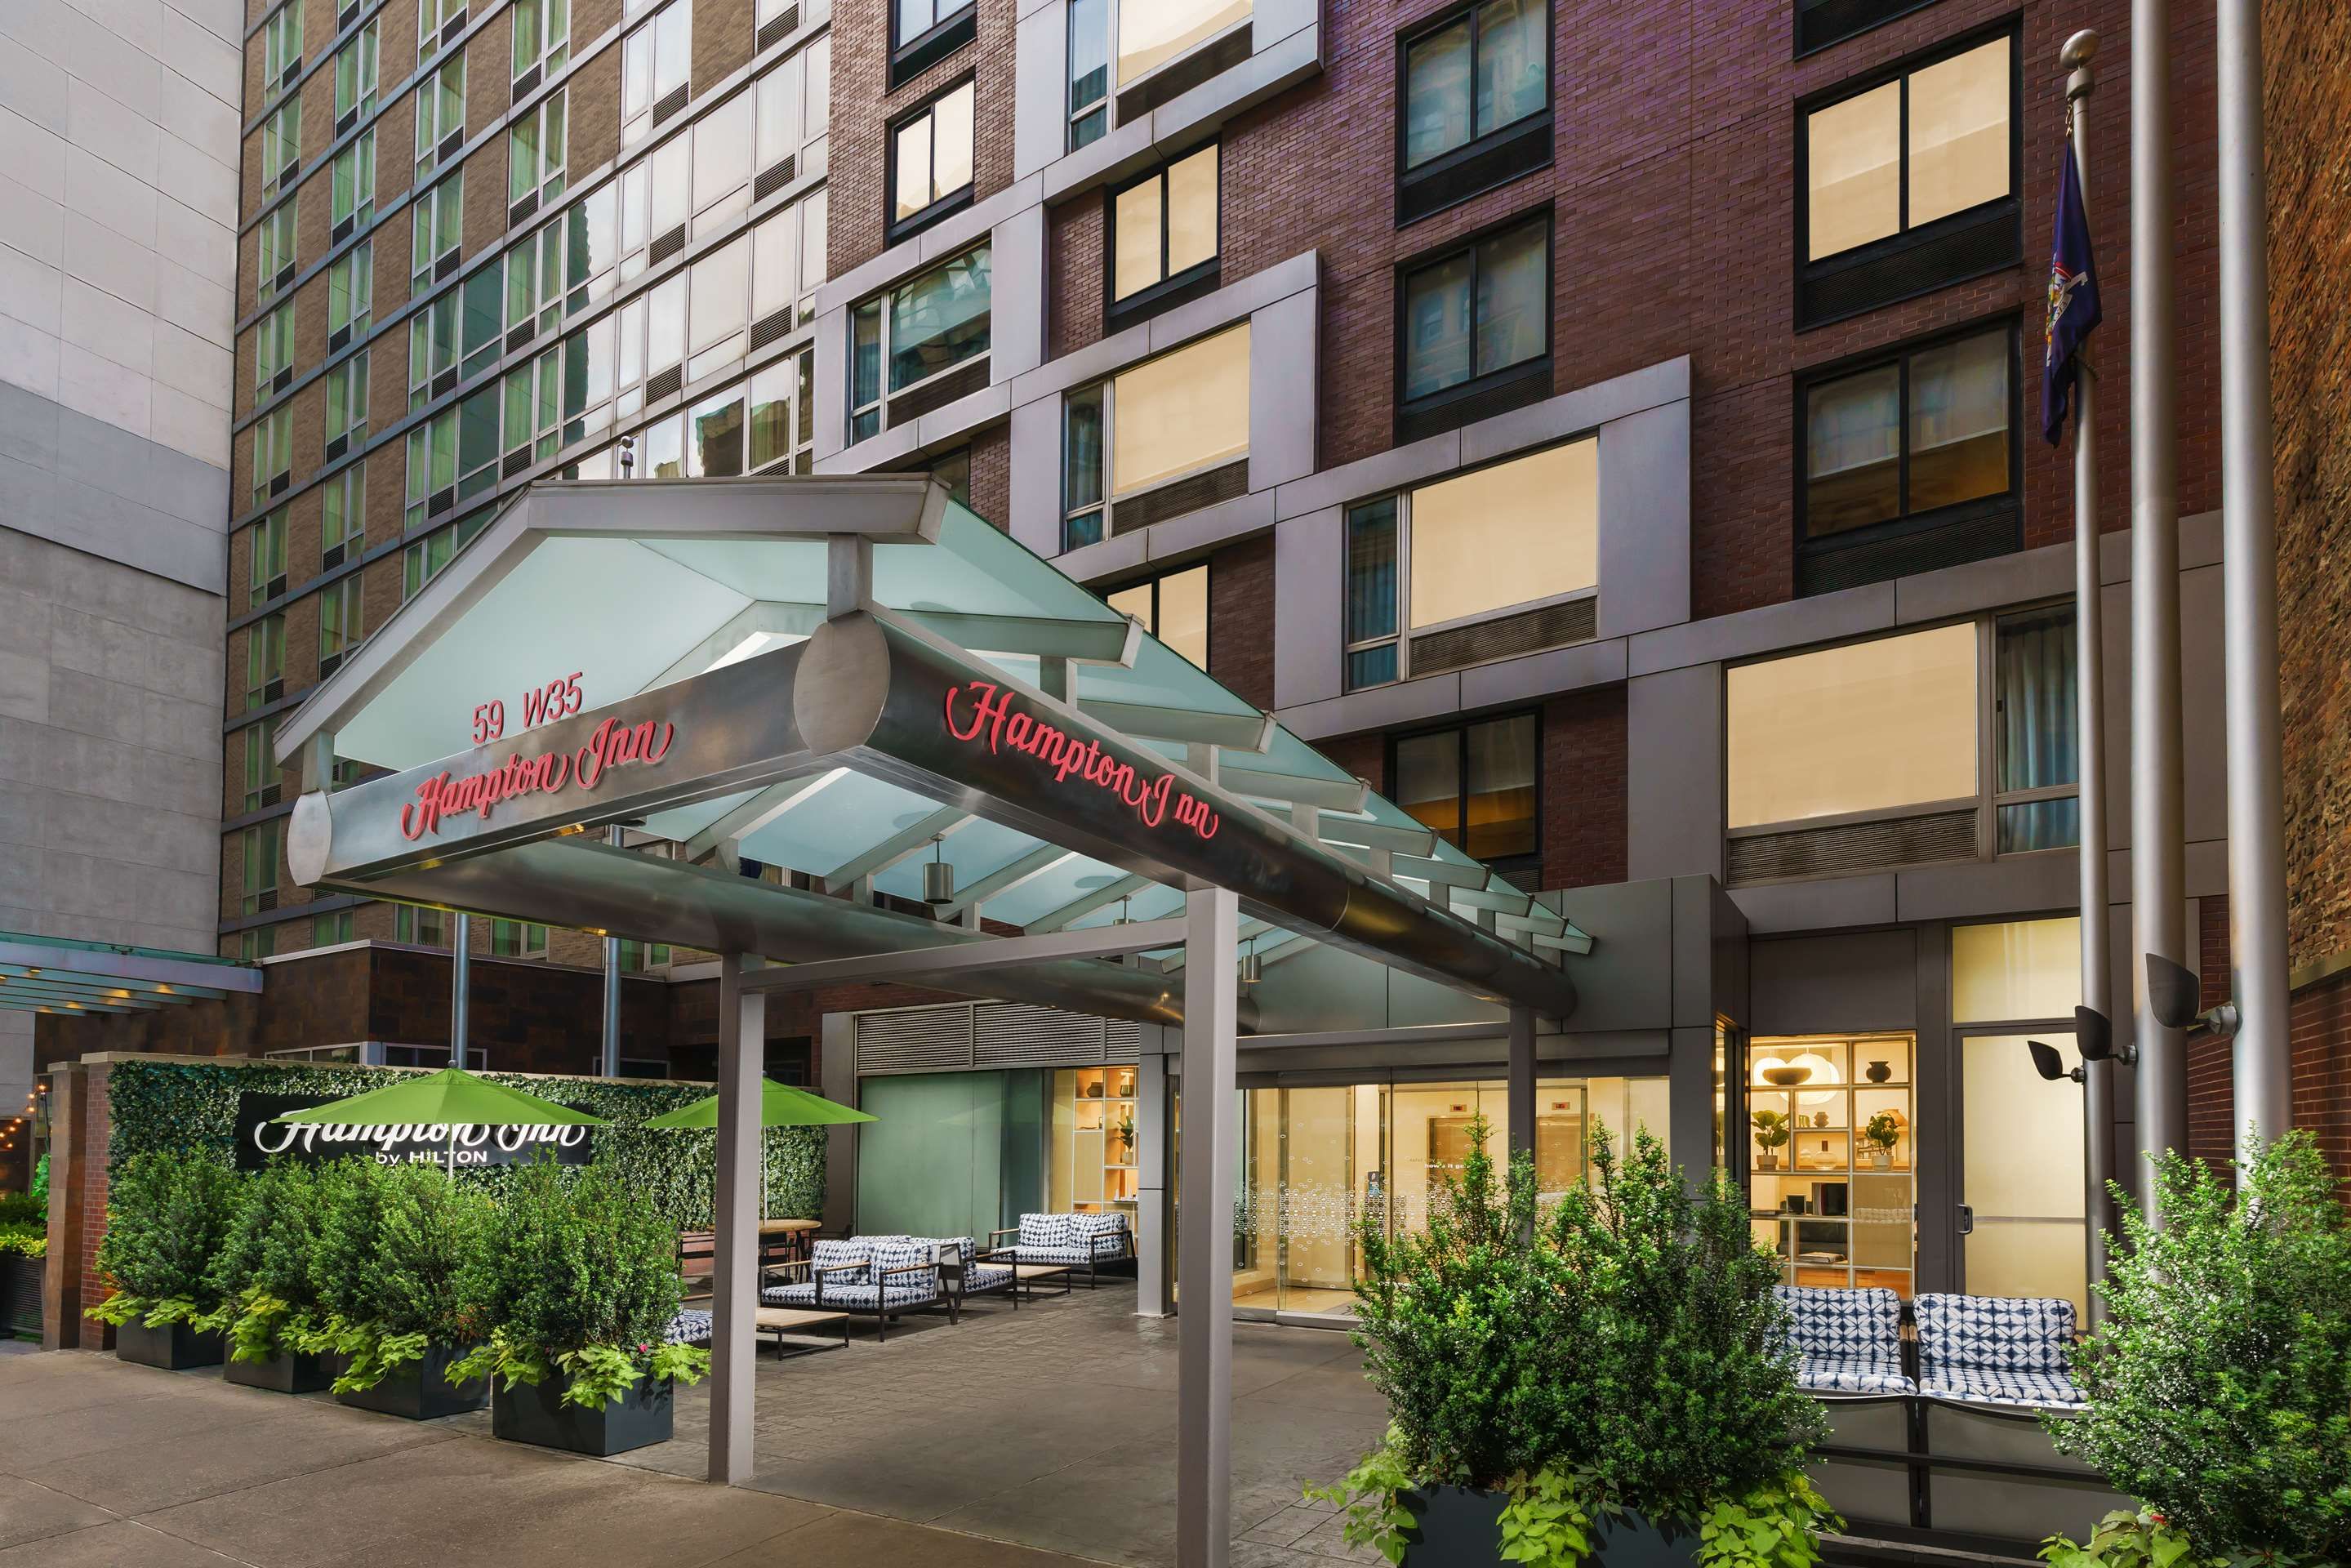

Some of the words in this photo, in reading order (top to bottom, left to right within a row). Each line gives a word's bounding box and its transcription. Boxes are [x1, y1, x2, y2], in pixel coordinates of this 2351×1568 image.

[471, 700, 504, 745] 59
[523, 671, 583, 729] W35
[400, 751, 569, 841] Hampton
[575, 716, 675, 790] Inn
[946, 680, 1147, 807] Hampton
[1141, 774, 1219, 840] Inn
[375, 1151, 401, 1166] by
